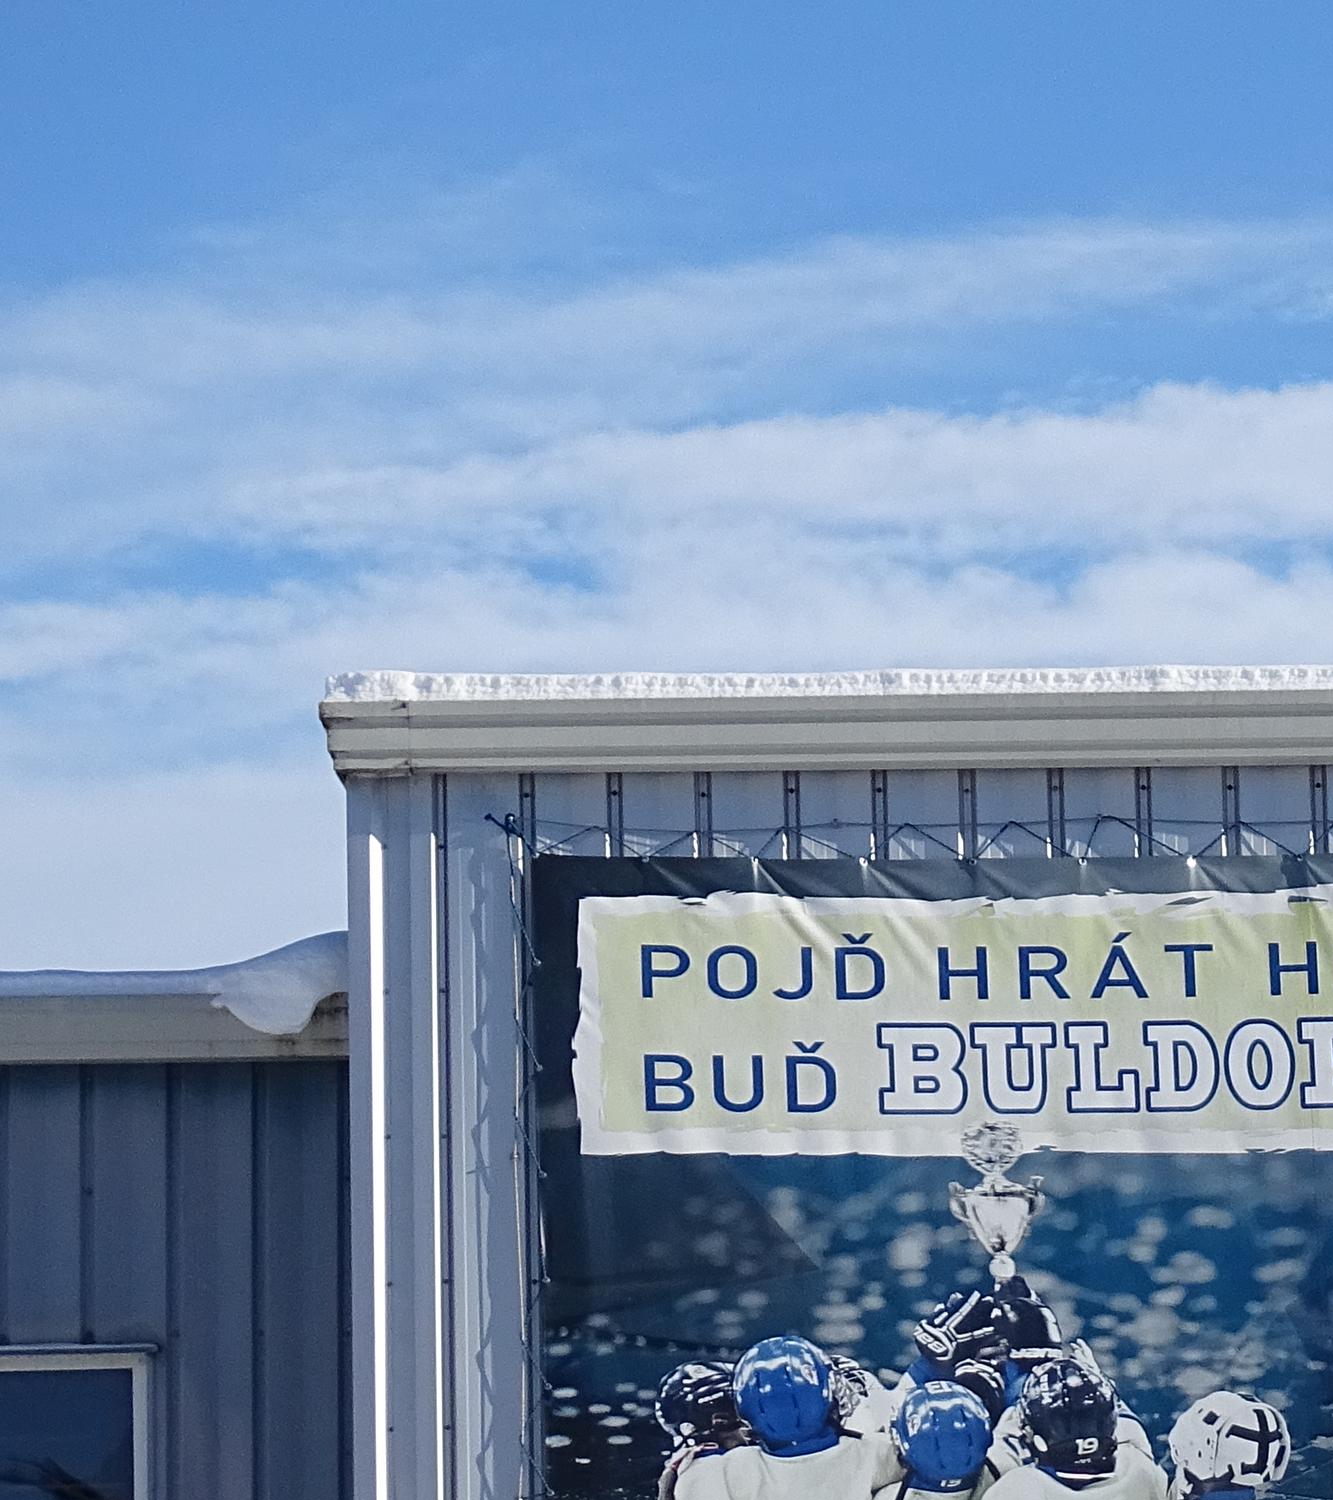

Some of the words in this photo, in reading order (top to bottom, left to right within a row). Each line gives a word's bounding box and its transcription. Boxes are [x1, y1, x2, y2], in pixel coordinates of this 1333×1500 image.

[640, 933, 886, 1001] POJĎ
[937, 932, 1213, 1001] HRÁT
[643, 1041, 837, 1114] BUĎ
[1075, 1437, 1099, 1455] 19
